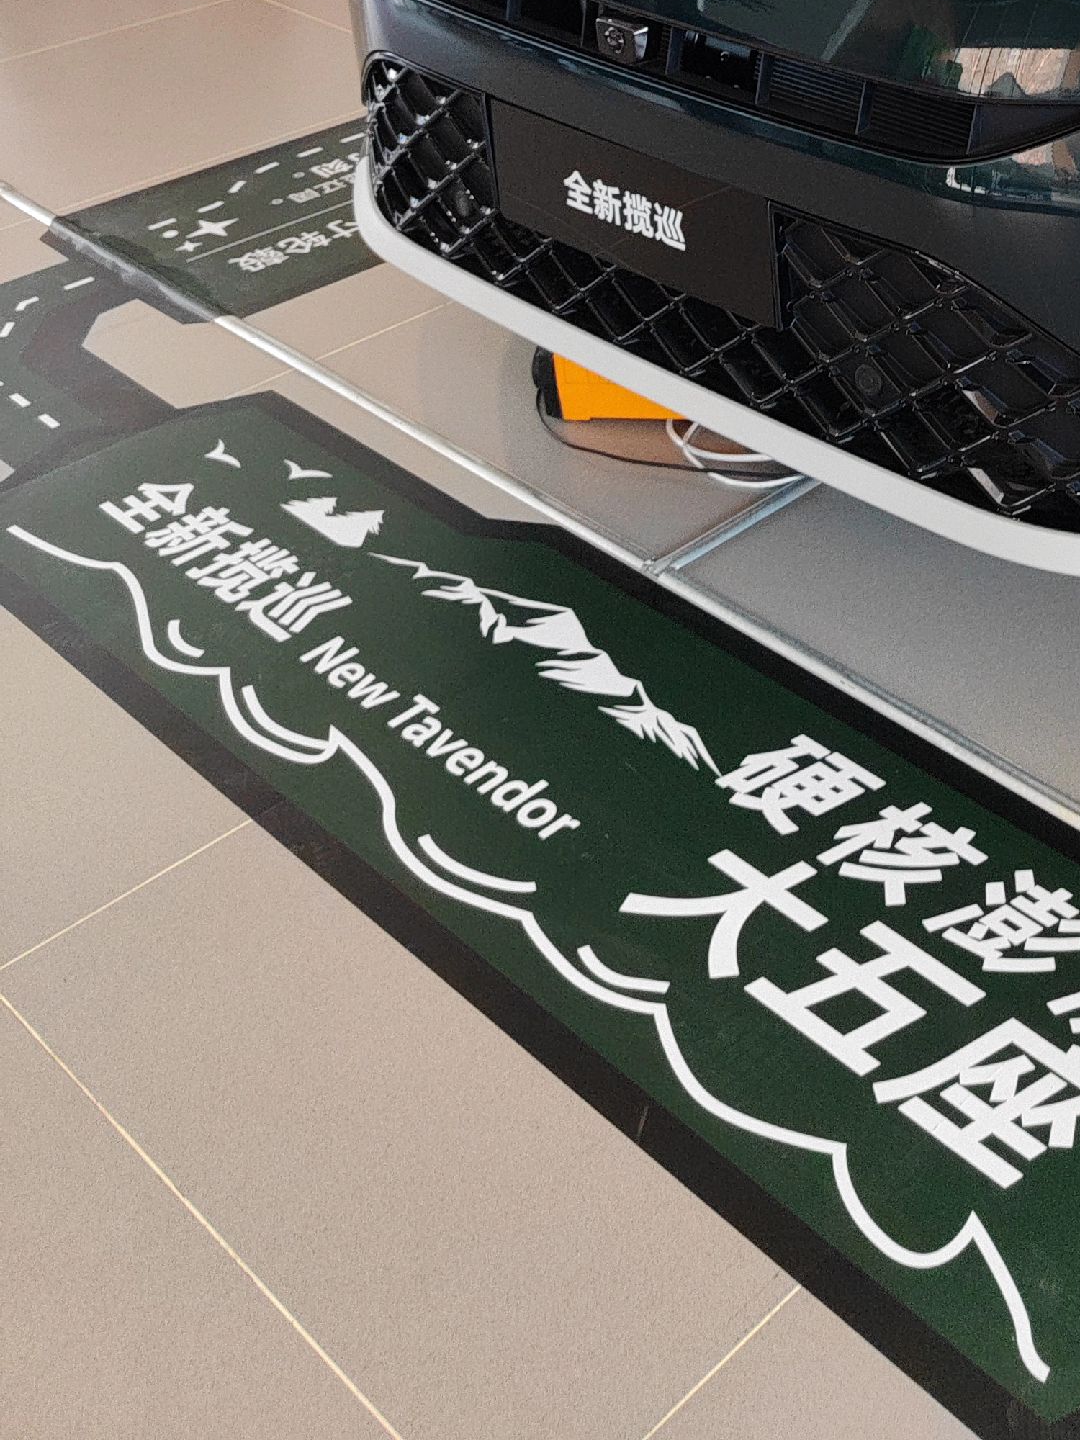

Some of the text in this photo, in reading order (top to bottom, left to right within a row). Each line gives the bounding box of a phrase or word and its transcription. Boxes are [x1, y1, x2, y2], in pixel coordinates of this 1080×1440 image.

[563, 169, 687, 252] 全新揽巡
[100, 481, 353, 643] 全新揽巡
[300, 635, 581, 841] New Tavendor
